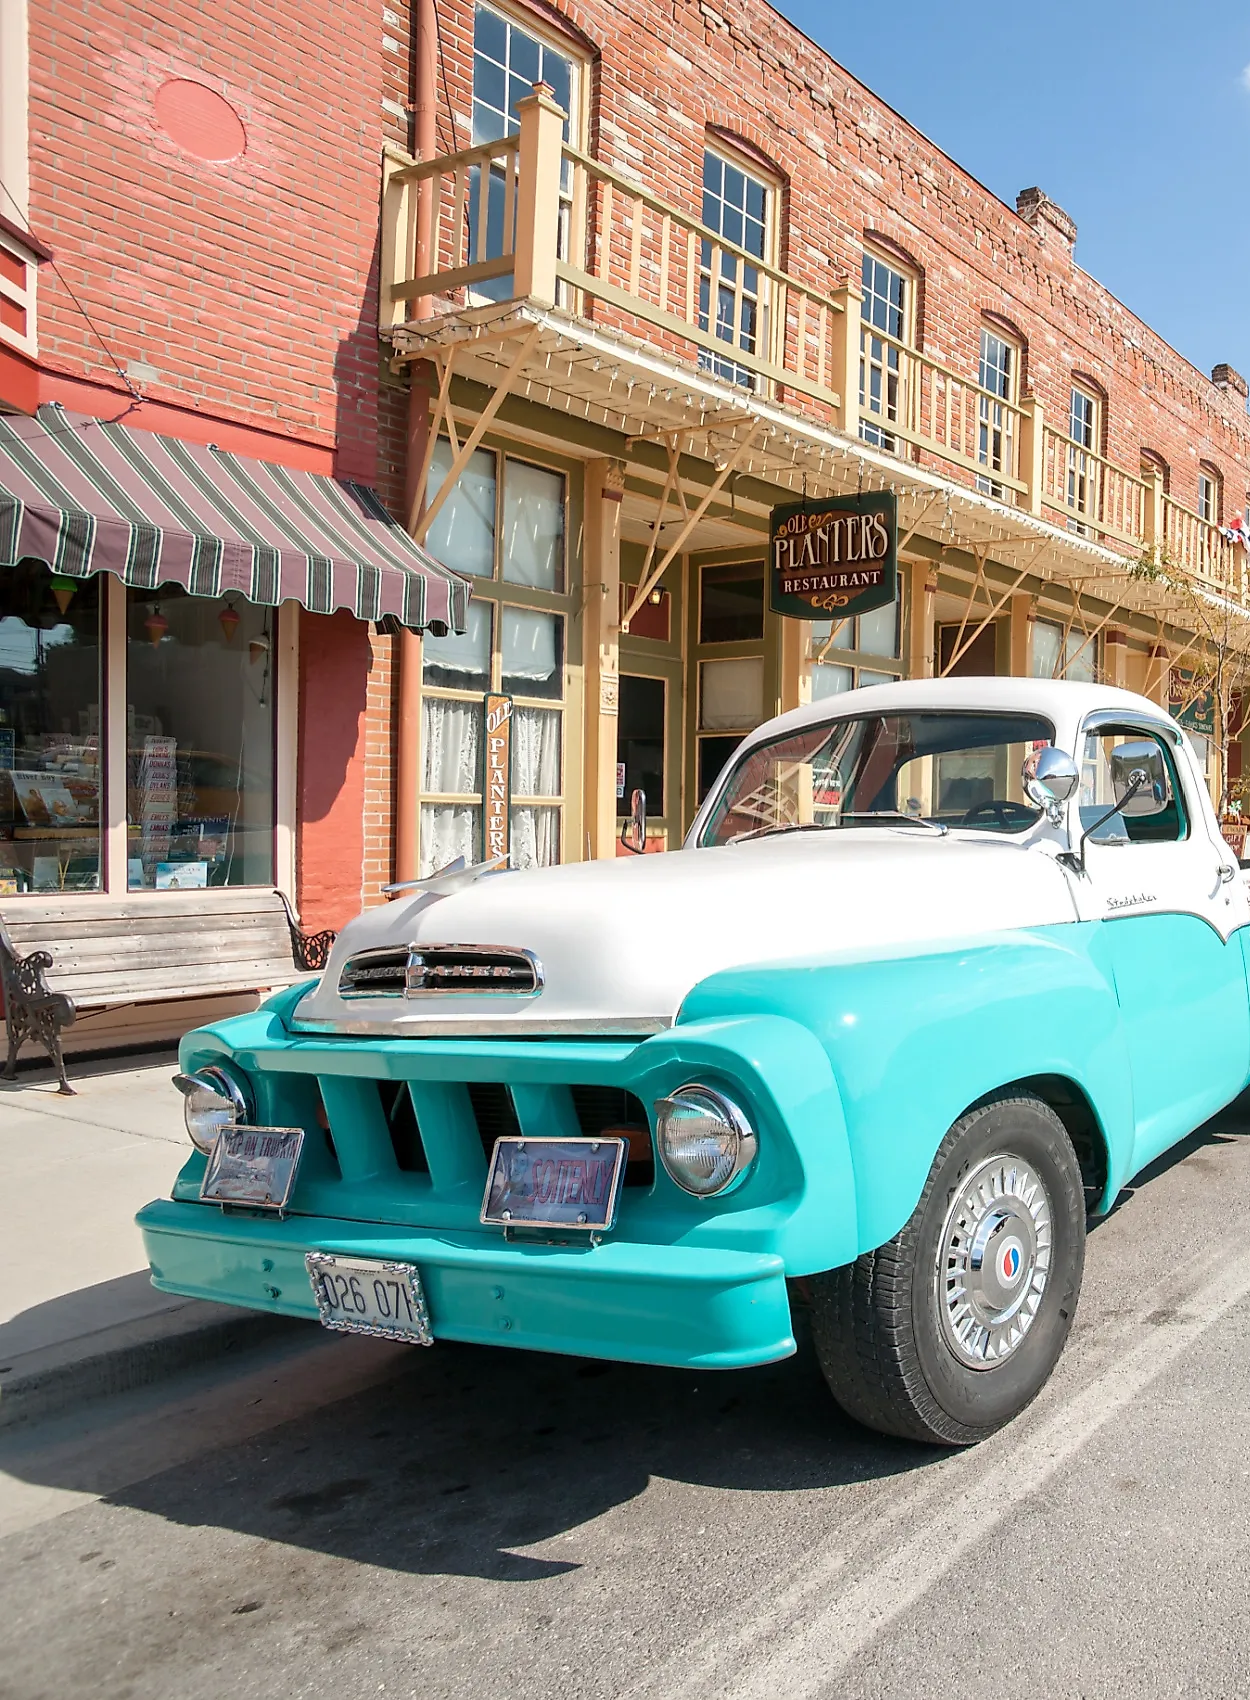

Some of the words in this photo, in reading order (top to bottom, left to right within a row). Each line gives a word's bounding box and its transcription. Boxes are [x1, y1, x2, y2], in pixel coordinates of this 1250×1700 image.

[775, 512, 889, 569] PLANTERS
[787, 513, 808, 534] OLE
[784, 570, 881, 593] RESTAURANT
[486, 701, 512, 733] OLE
[489, 737, 505, 860] PLANTERS
[527, 1158, 616, 1205] SOITENLY
[320, 1272, 366, 1314] 026
